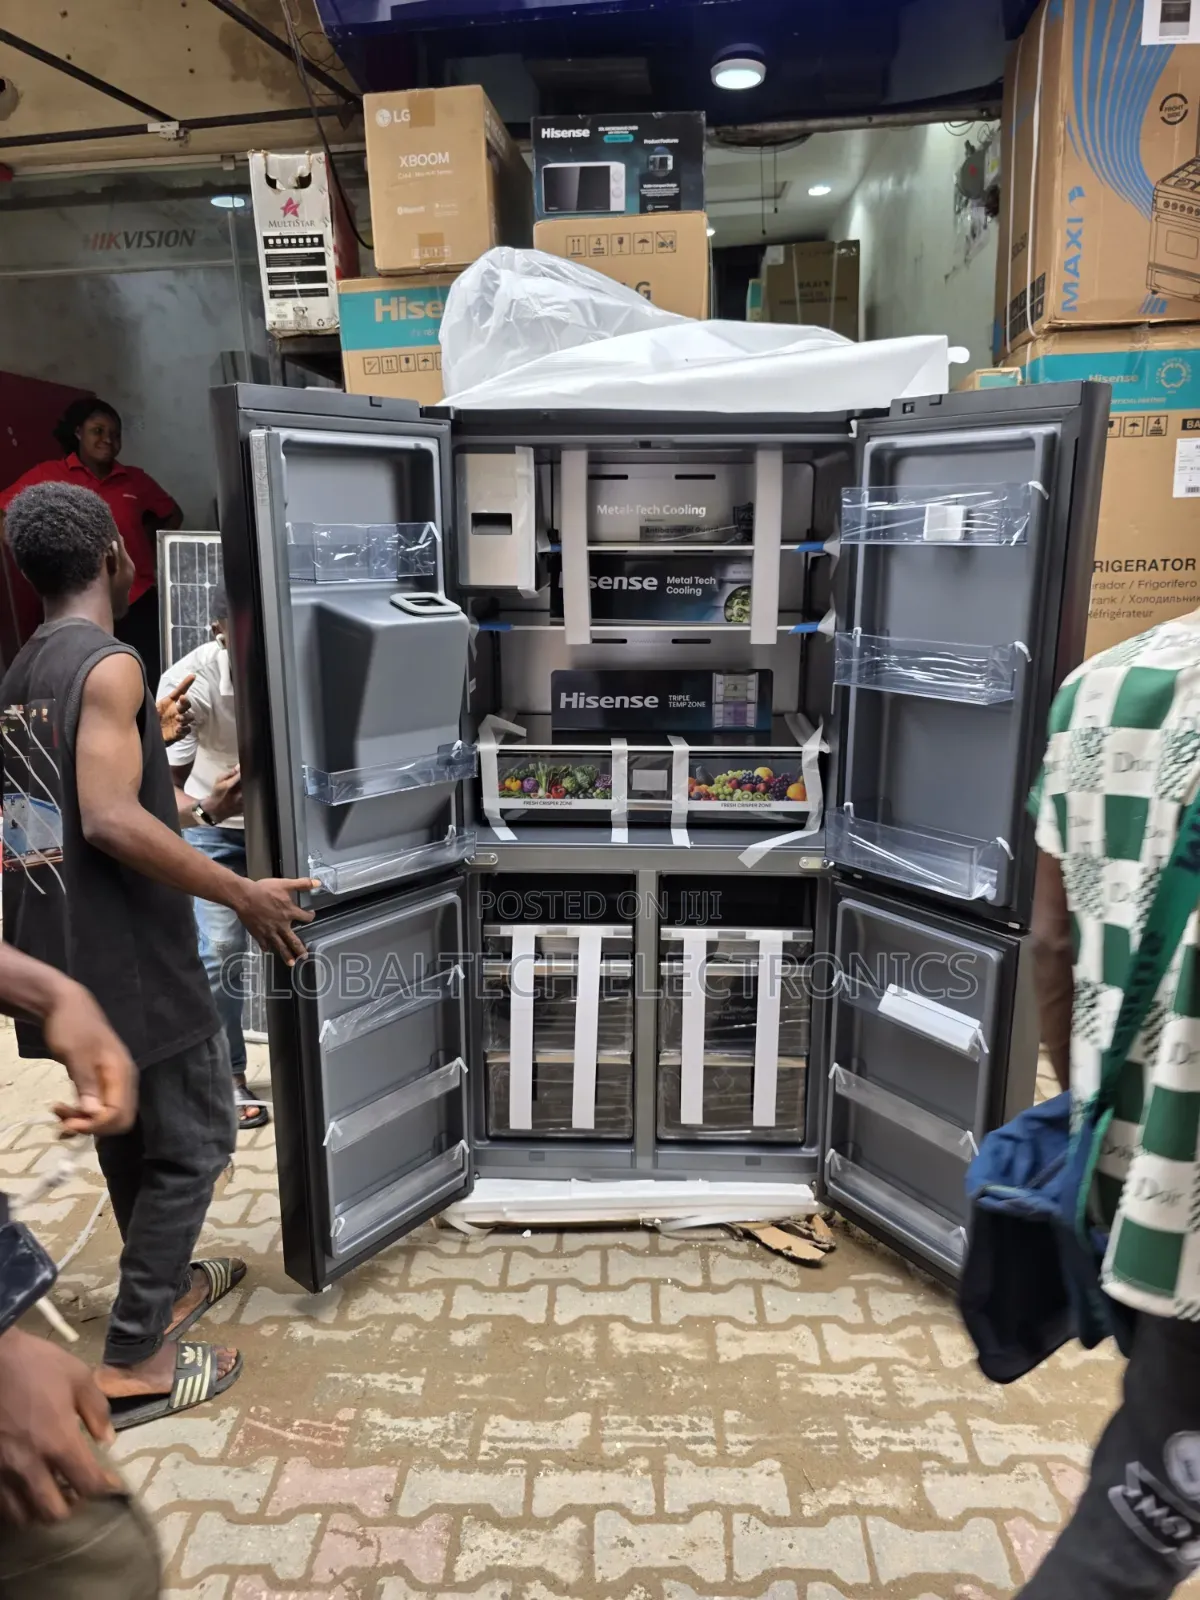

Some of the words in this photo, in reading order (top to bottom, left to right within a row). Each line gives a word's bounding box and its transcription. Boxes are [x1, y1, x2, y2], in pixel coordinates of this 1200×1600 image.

[393, 109, 411, 123] LG
[541, 127, 590, 138] Hisense
[399, 152, 450, 168] XBOOM
[83, 229, 196, 249] HIKVISION
[1060, 216, 1084, 313] MAXI
[1088, 373, 1139, 383] Hisense
[663, 504, 706, 517] Cooling
[667, 576, 692, 585] Metal
[695, 576, 716, 585] Tech
[666, 586, 702, 596] Cooling
[560, 692, 659, 709] Hisense
